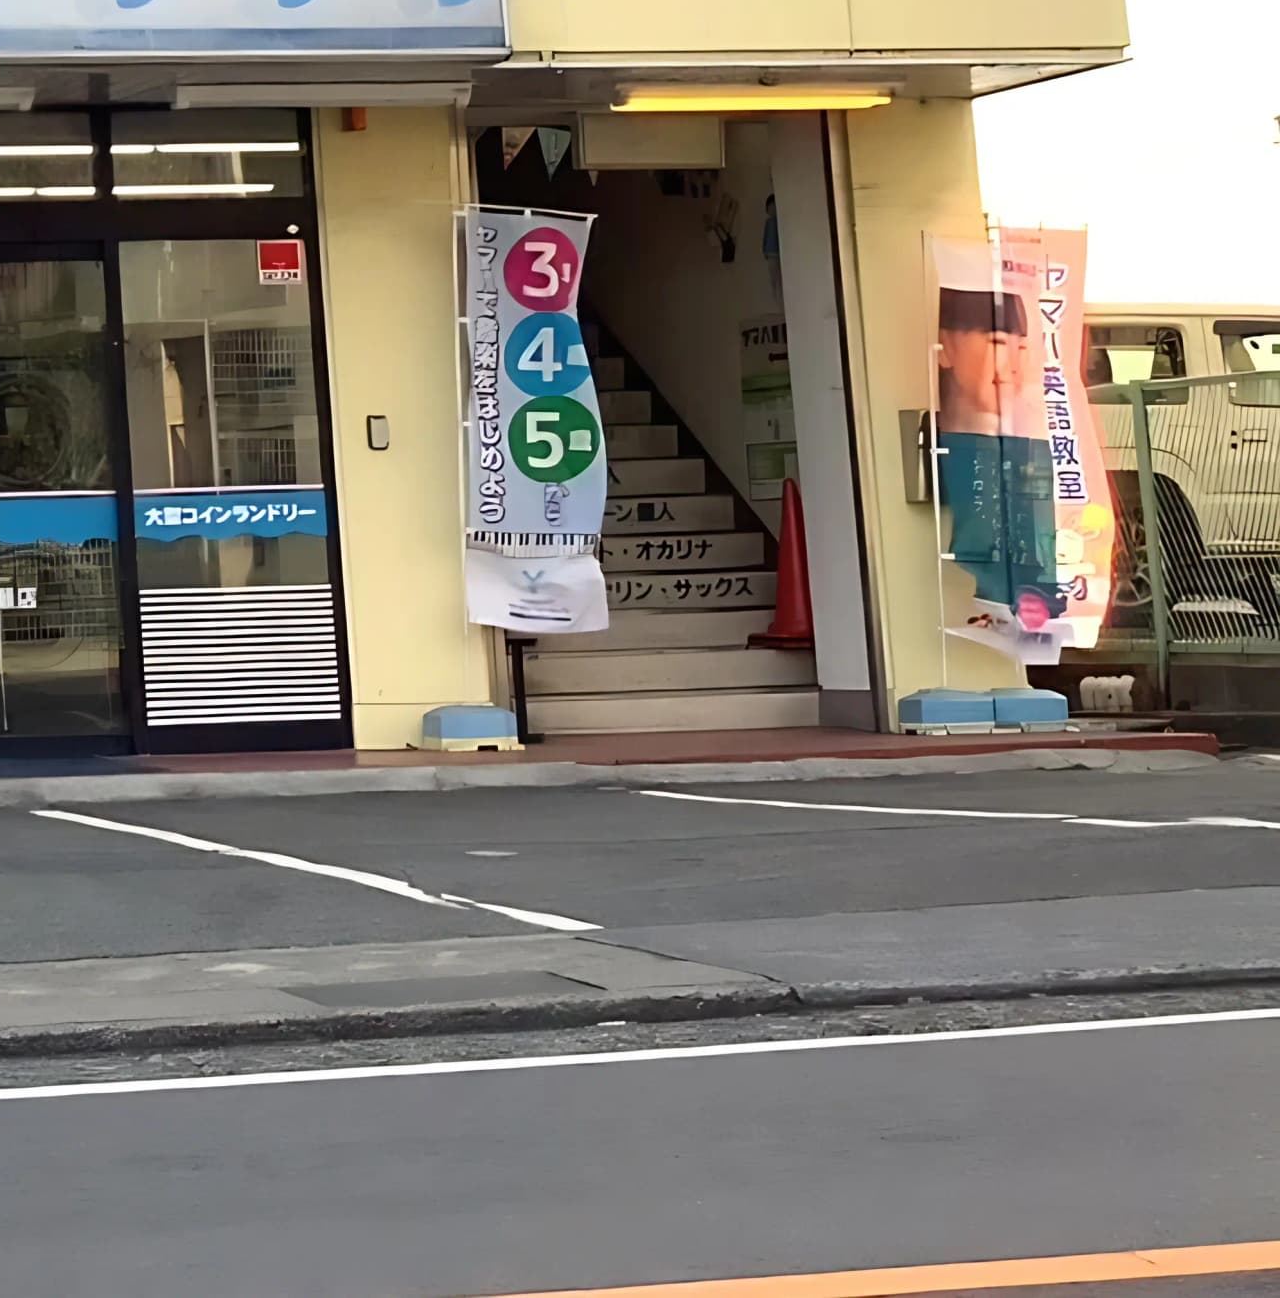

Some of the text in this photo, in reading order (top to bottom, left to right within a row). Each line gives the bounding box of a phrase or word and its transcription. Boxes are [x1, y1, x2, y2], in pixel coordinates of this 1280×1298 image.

[144, 503, 318, 527] 大コインランドリー
